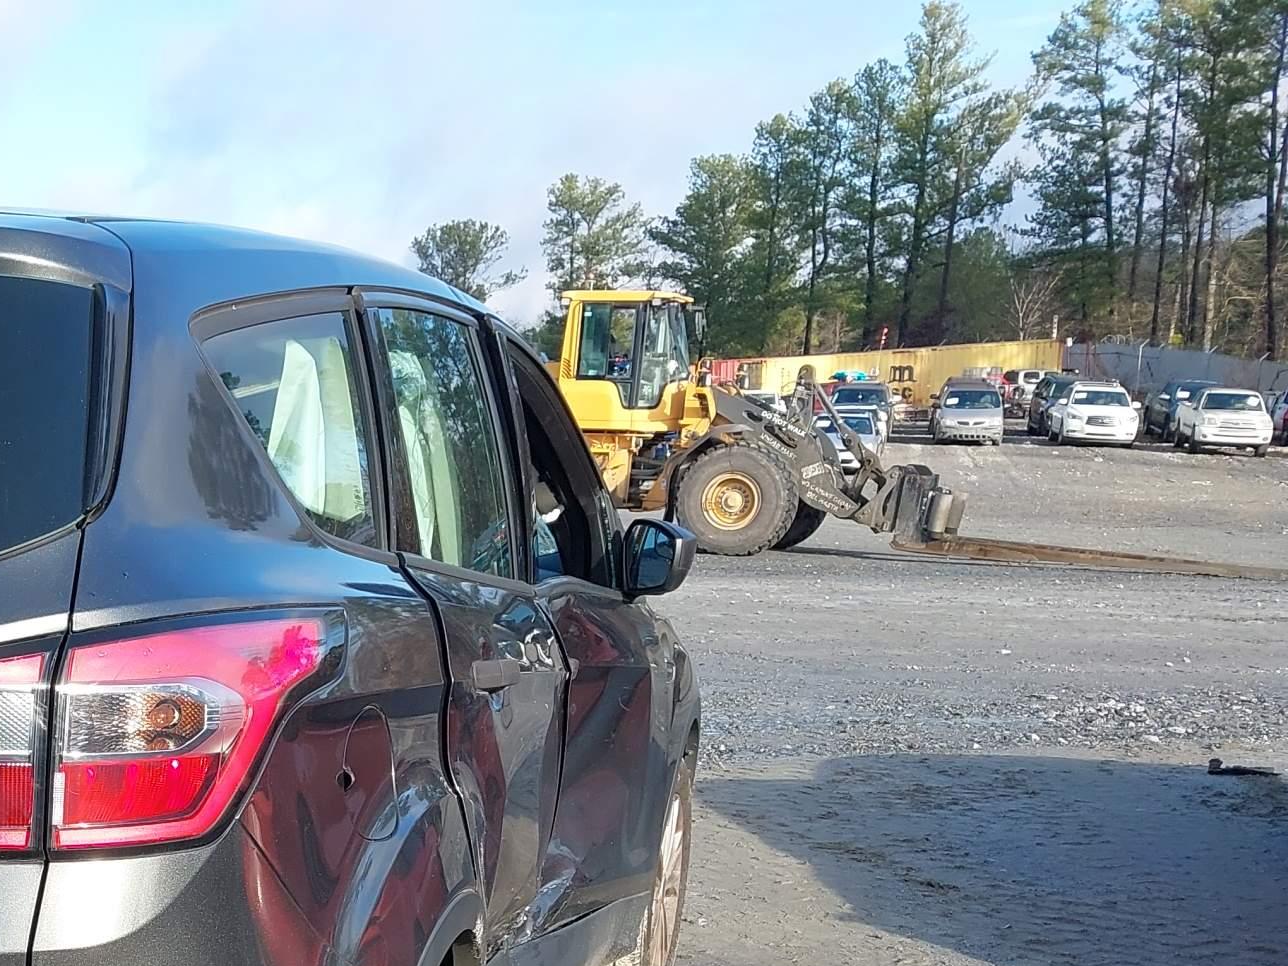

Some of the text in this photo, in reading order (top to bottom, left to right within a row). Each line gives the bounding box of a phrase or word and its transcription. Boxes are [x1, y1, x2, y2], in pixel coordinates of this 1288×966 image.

[761, 410, 807, 437] DO NOT WALK
